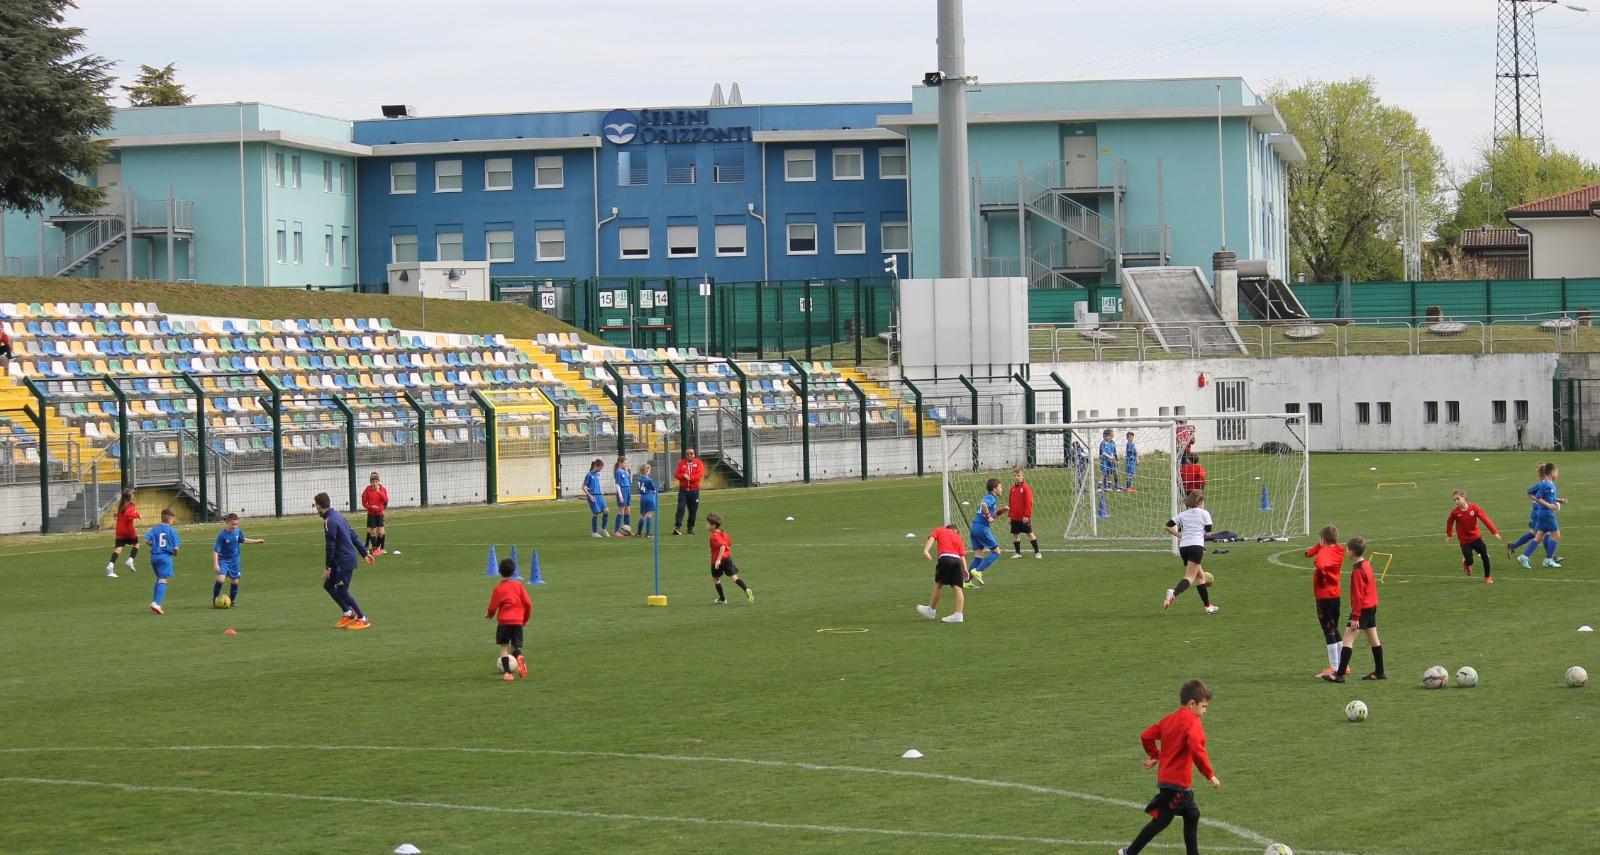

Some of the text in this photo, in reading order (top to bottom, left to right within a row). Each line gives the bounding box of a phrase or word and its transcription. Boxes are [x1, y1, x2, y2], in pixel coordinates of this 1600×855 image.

[641, 109, 709, 126] SERENI
[641, 126, 752, 144] ORIZZONTI
[542, 295, 554, 306] 16
[600, 294, 612, 304] 15
[656, 294, 667, 303] 14
[637, 481, 646, 493] 14
[159, 532, 167, 548] 6
